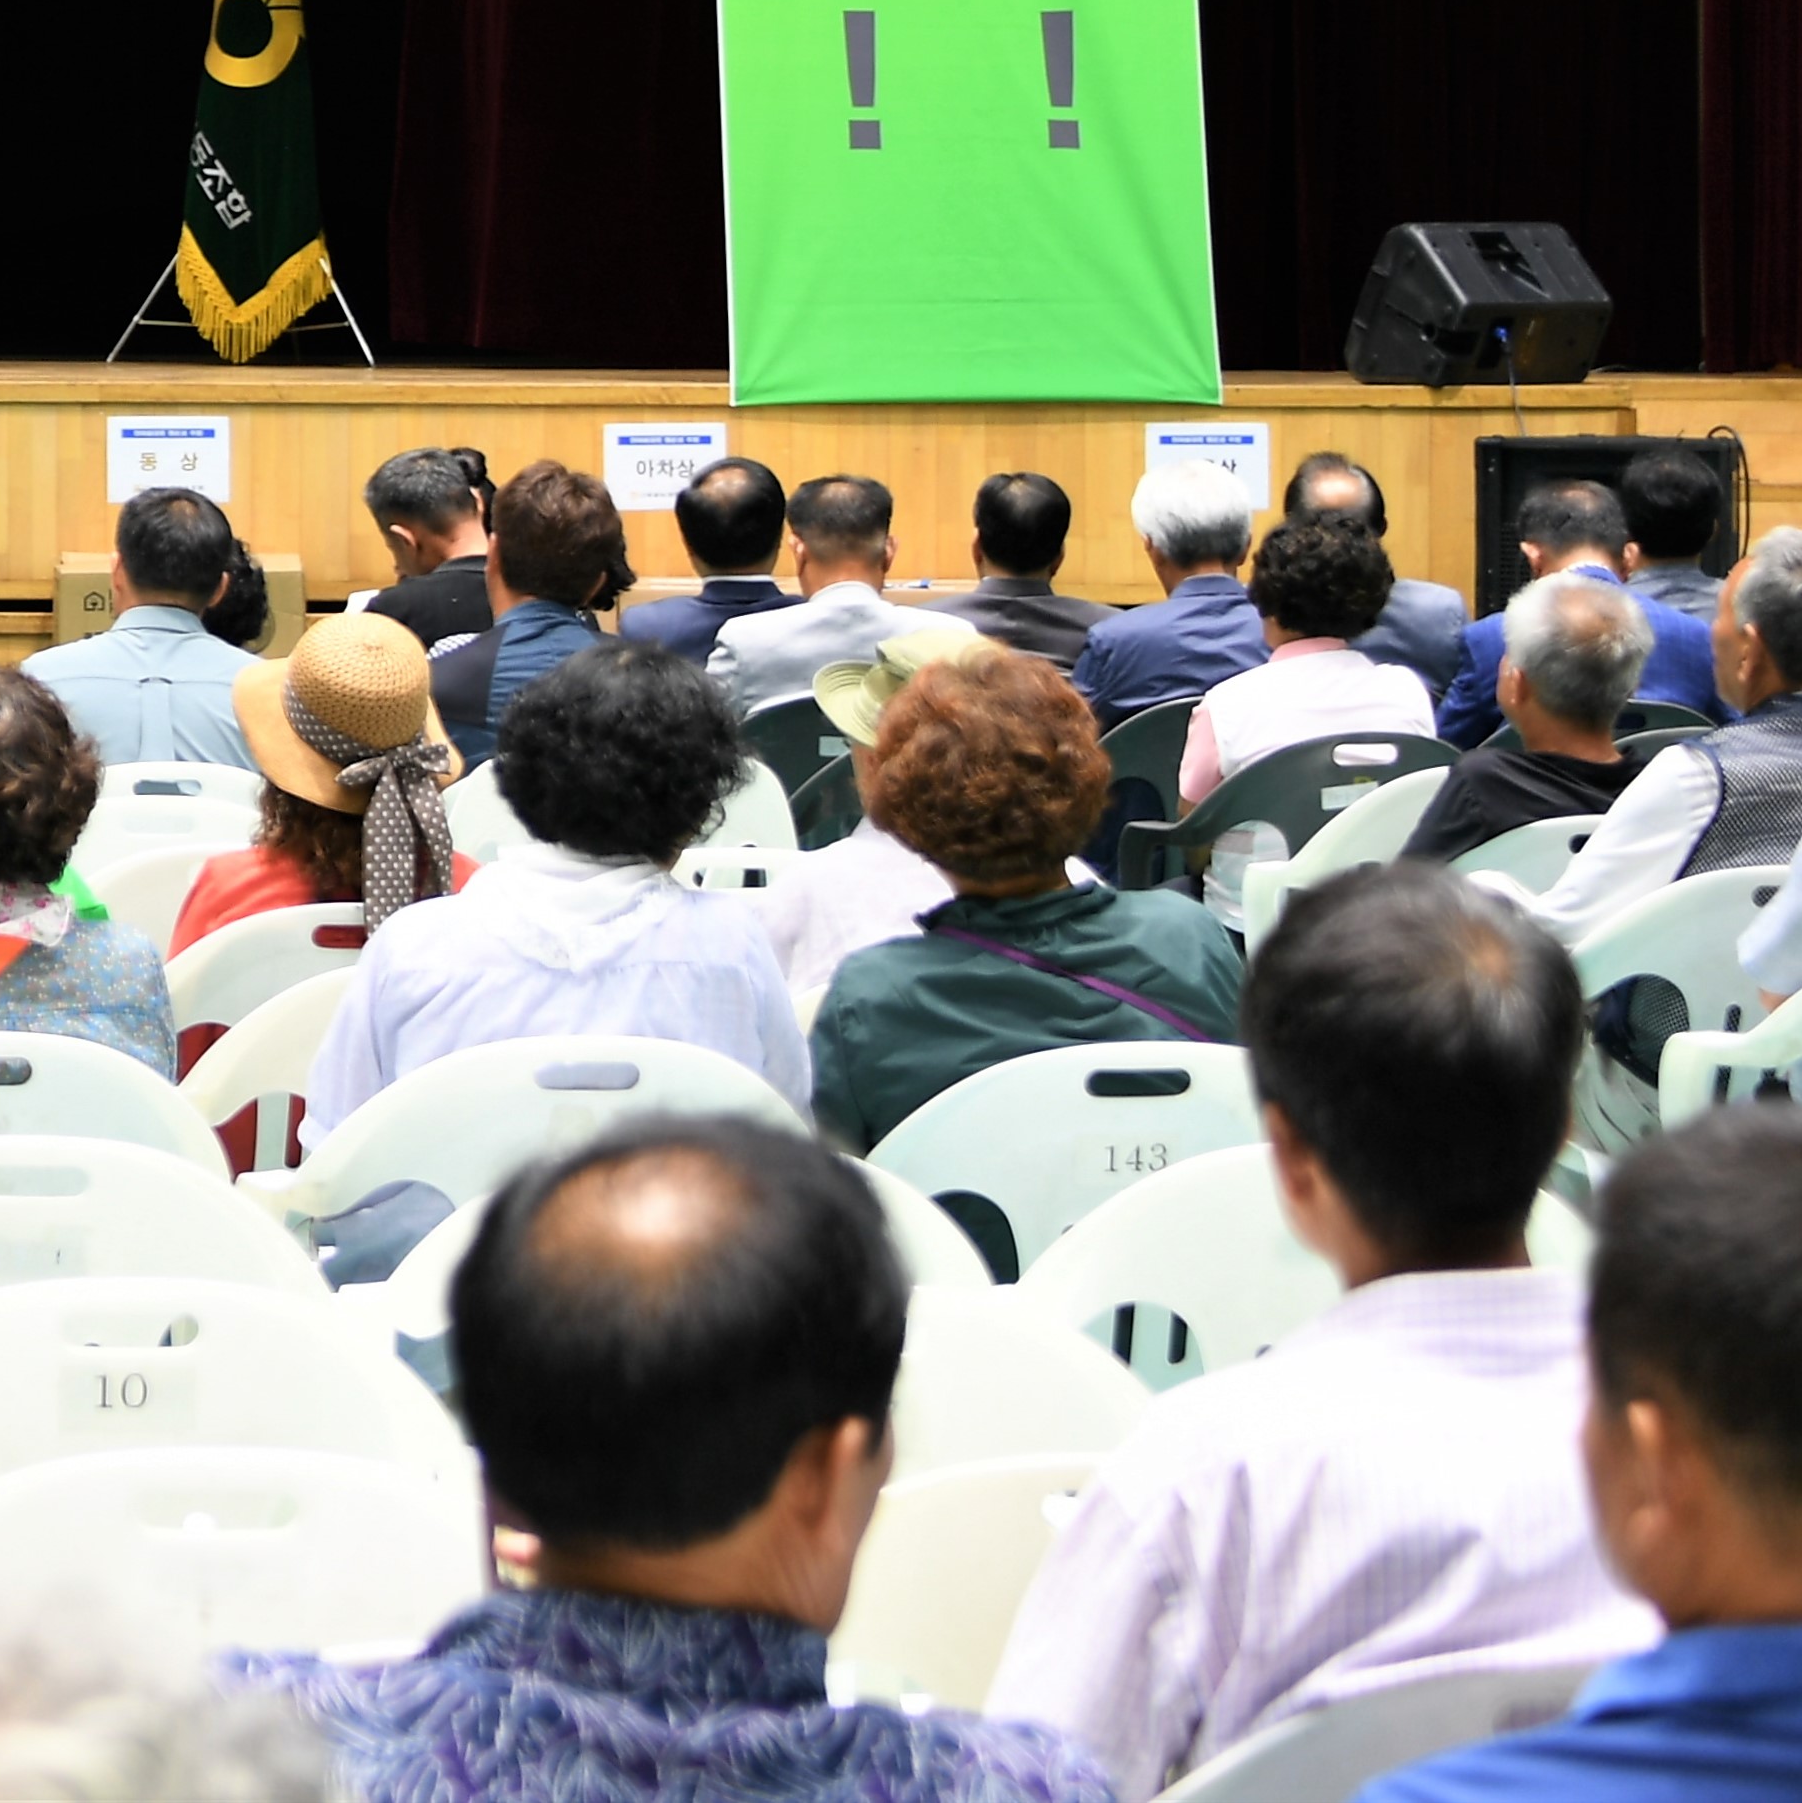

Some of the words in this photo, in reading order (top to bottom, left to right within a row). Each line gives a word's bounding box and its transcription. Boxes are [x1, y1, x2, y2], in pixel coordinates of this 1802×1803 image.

[636, 458, 695, 479] 아차상
[1103, 1142, 1168, 1173] 143
[94, 1371, 149, 1409] 10
